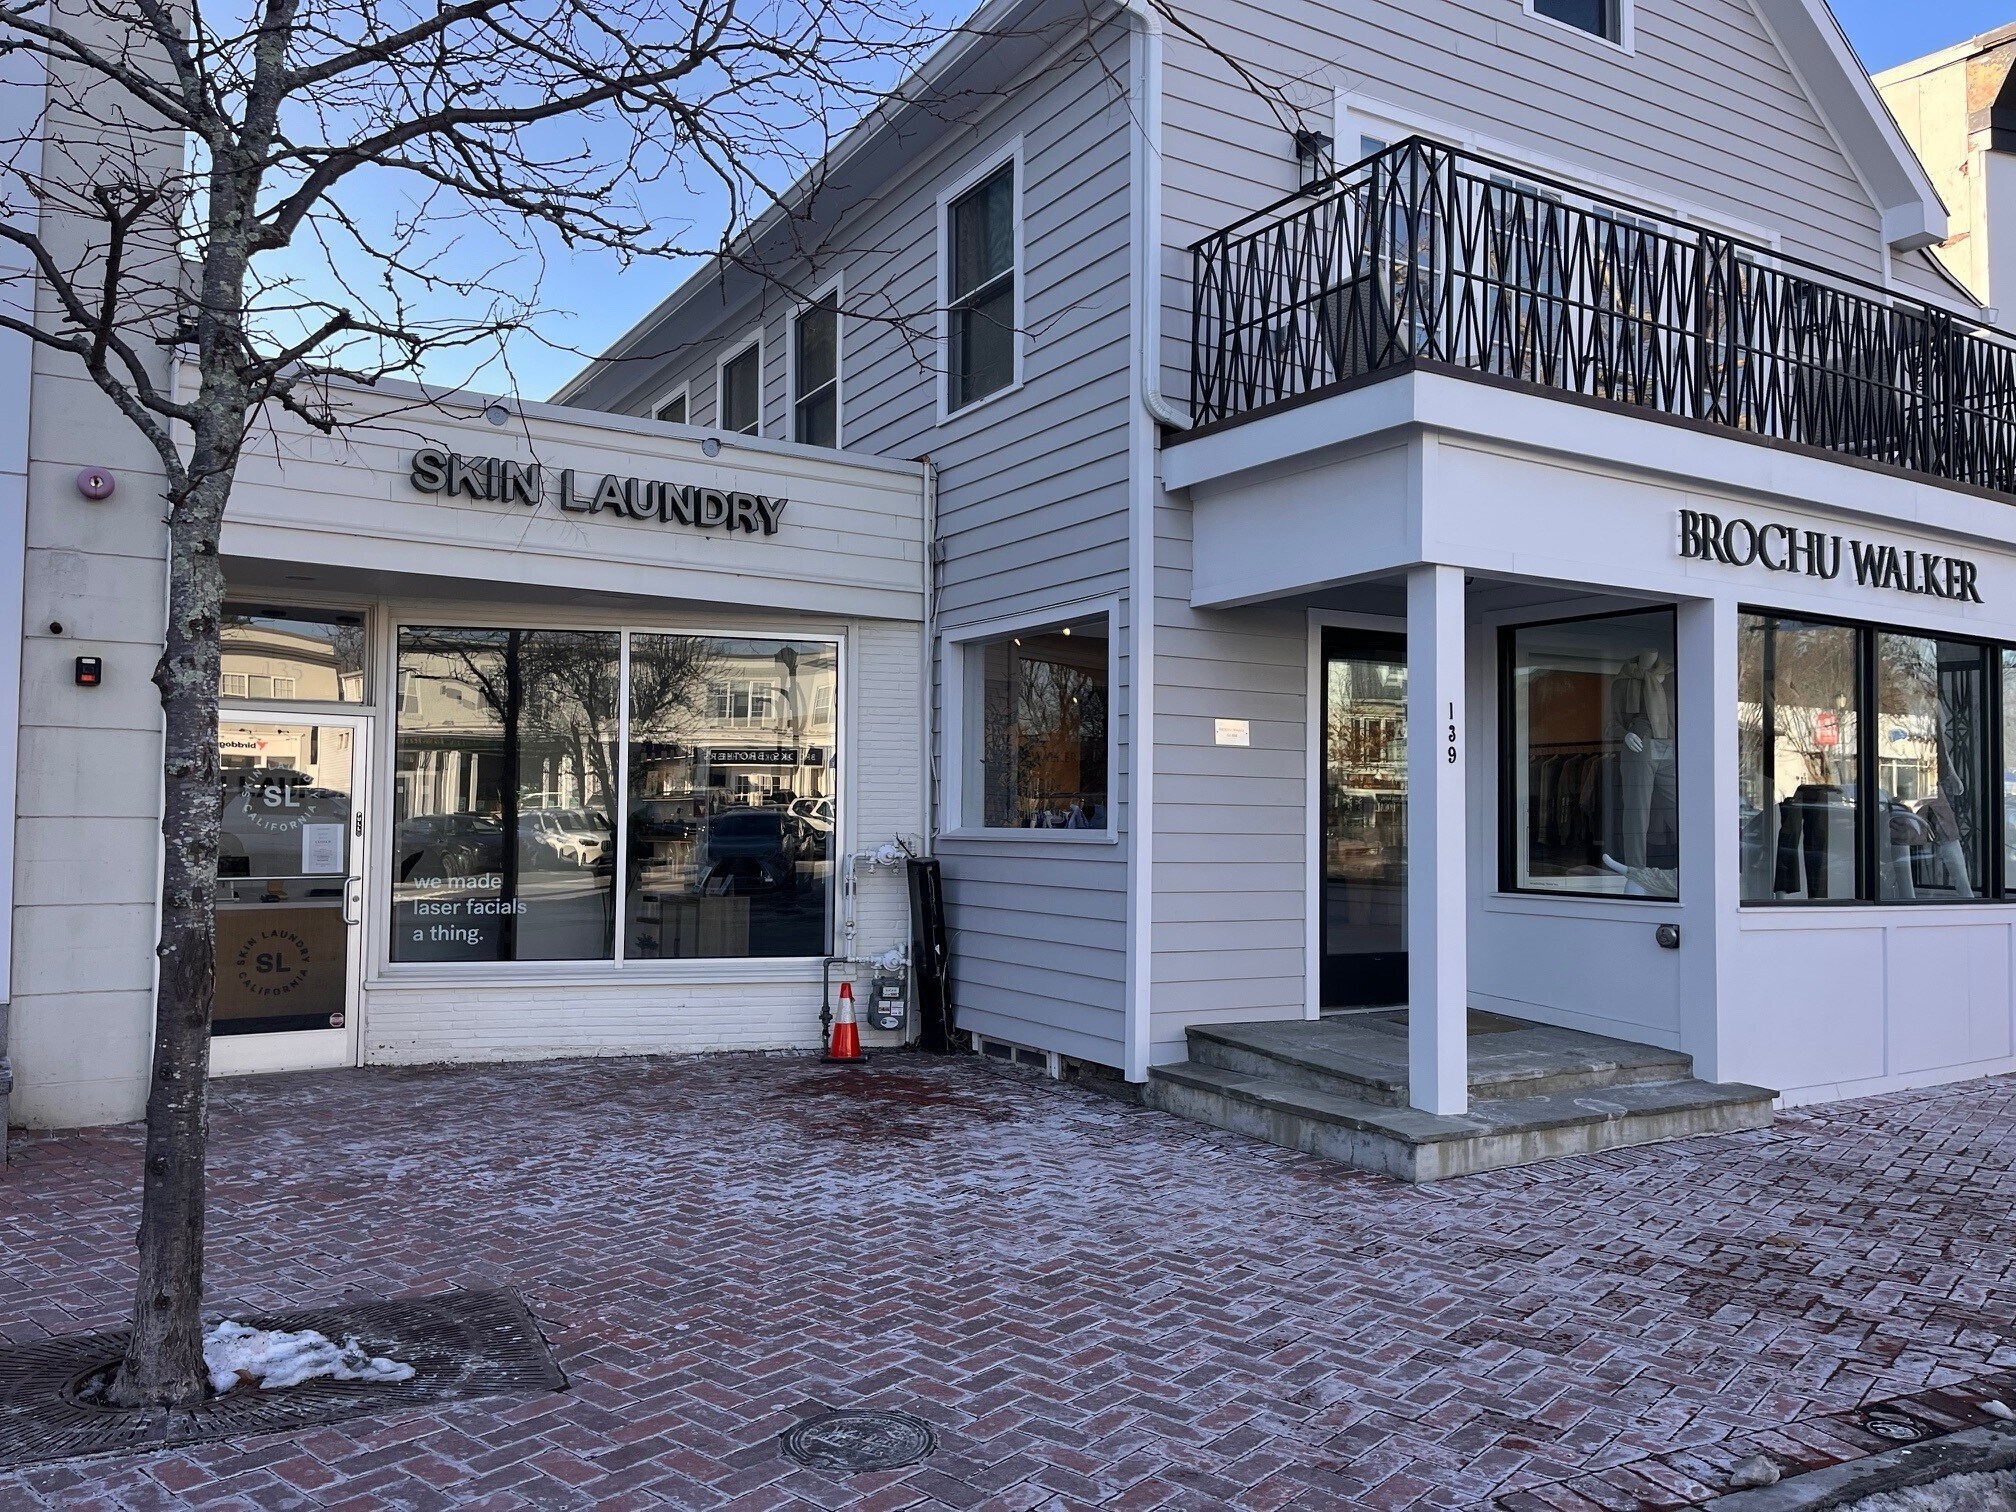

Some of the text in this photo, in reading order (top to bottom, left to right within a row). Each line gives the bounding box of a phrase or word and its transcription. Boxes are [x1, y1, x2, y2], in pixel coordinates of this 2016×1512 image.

[410, 448, 789, 536] SKIN LAUNDRY
[1679, 509, 1985, 604] BROCHU WALKER
[1447, 702, 1457, 764] 139
[241, 769, 263, 798] SKIN
[263, 785, 301, 808] SL
[242, 804, 317, 832] CALIFORNIA
[413, 872, 503, 889] we made
[413, 898, 527, 915] laser facials
[236, 929, 310, 966] SKIN LAUNDRY
[412, 924, 484, 945] a thing.
[256, 952, 291, 974] SL
[238, 969, 308, 996] CALIFORNIA
